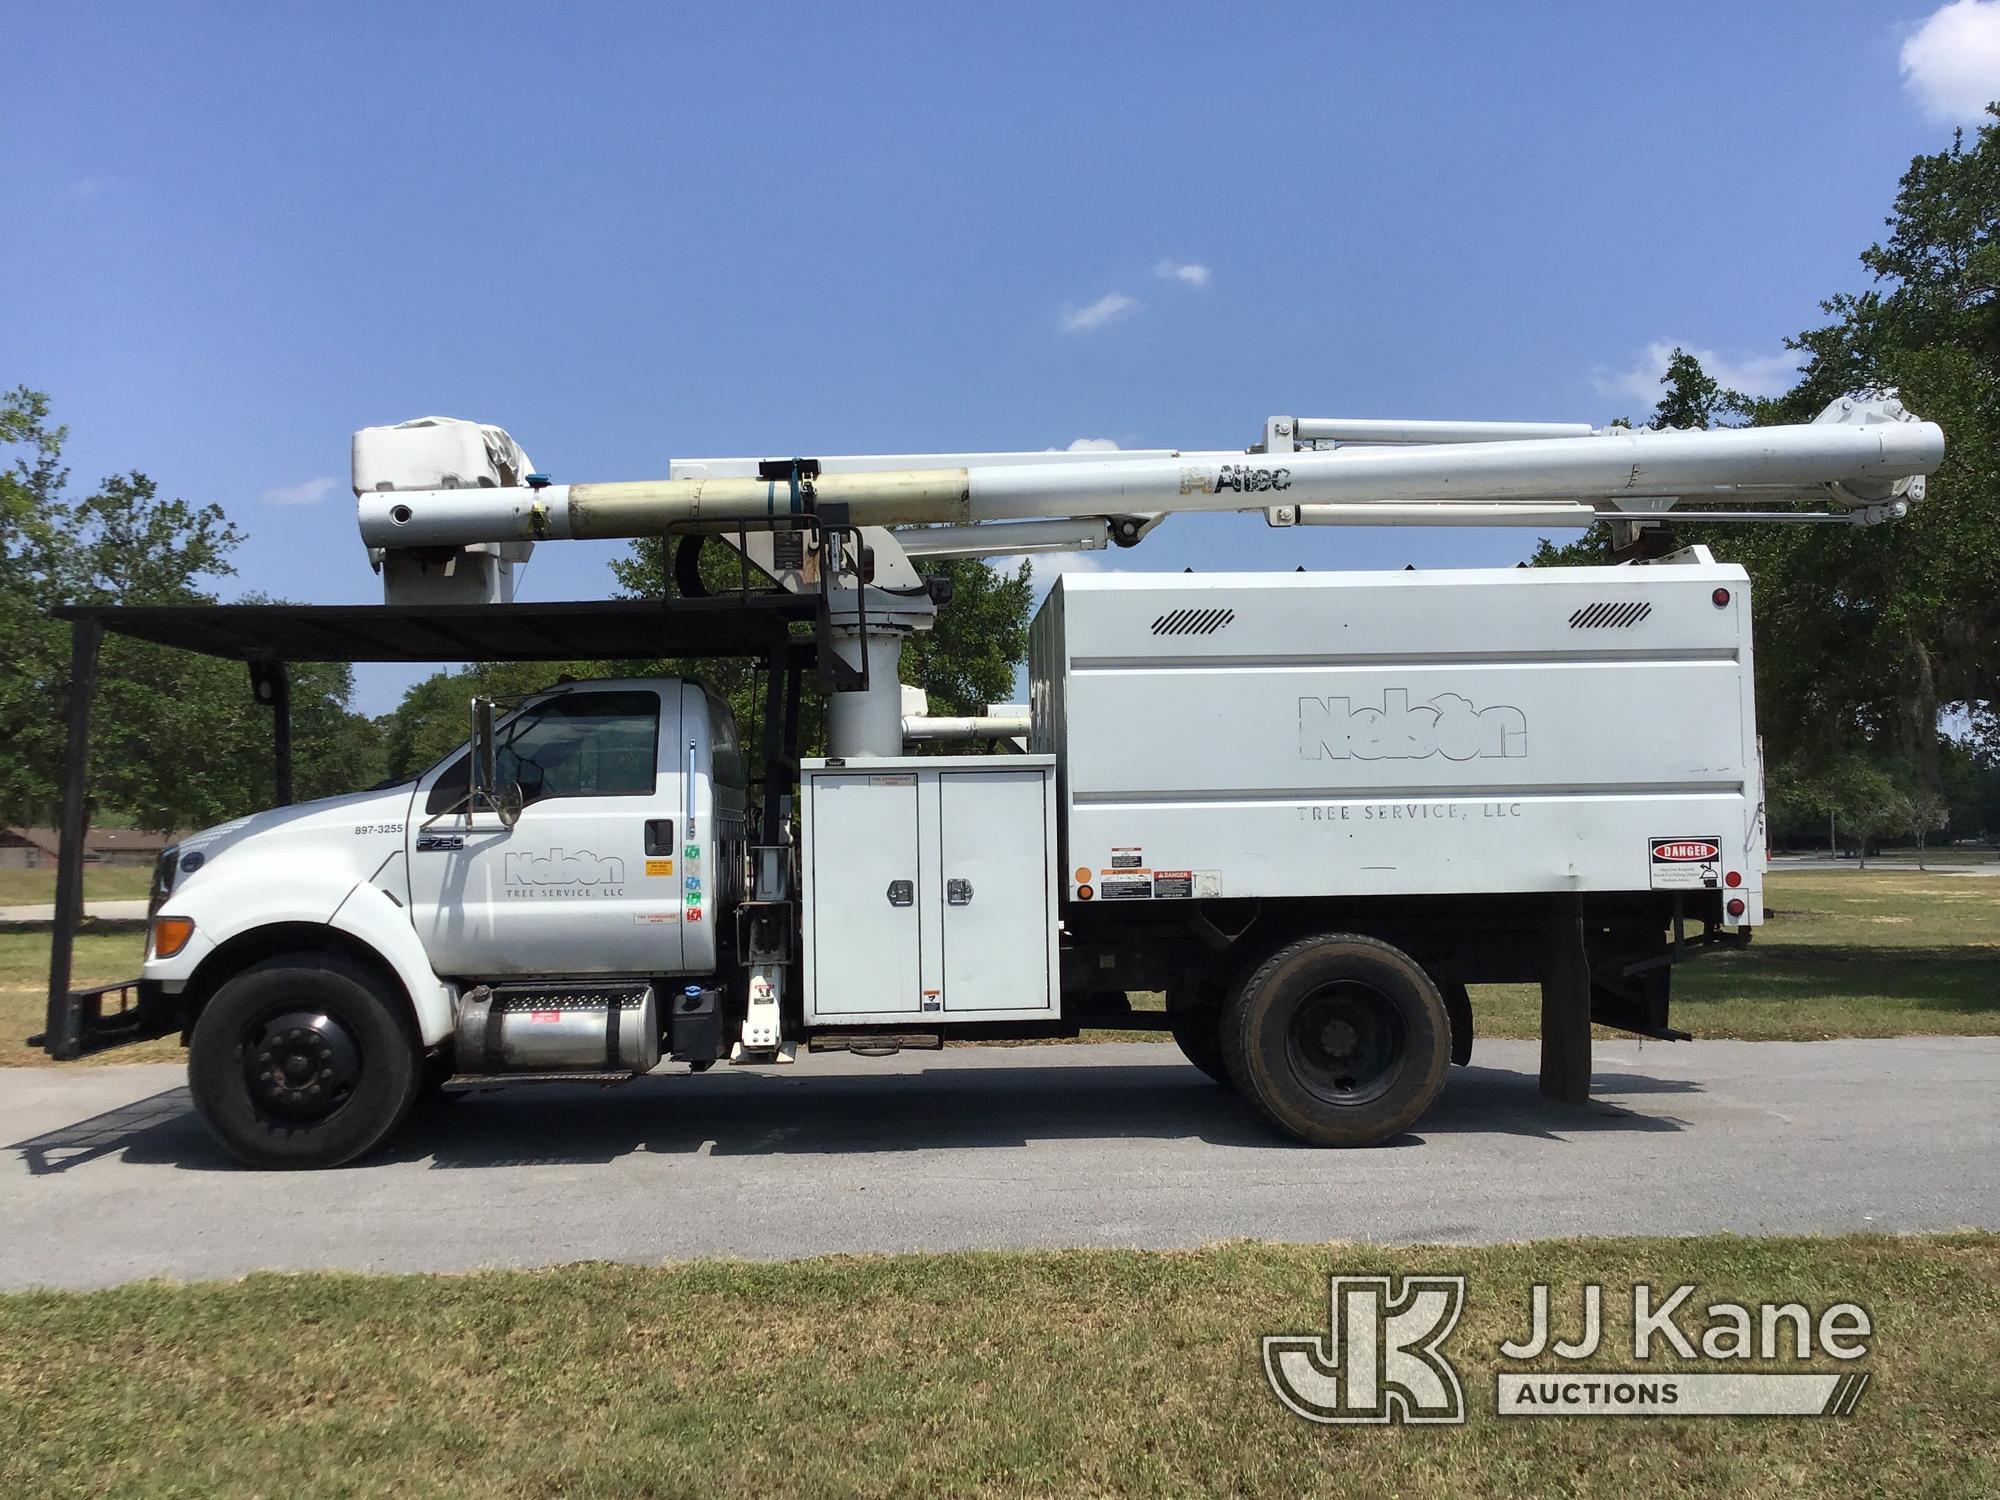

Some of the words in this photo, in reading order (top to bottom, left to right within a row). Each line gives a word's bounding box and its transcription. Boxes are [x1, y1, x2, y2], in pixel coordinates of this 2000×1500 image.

[1297, 806, 1350, 820] TREE
[1483, 803, 1521, 817] LLC
[354, 824, 404, 835] 897-3255
[1664, 845, 1708, 857] DANGER
[507, 889, 535, 898] TREE
[603, 888, 624, 897] LLC
